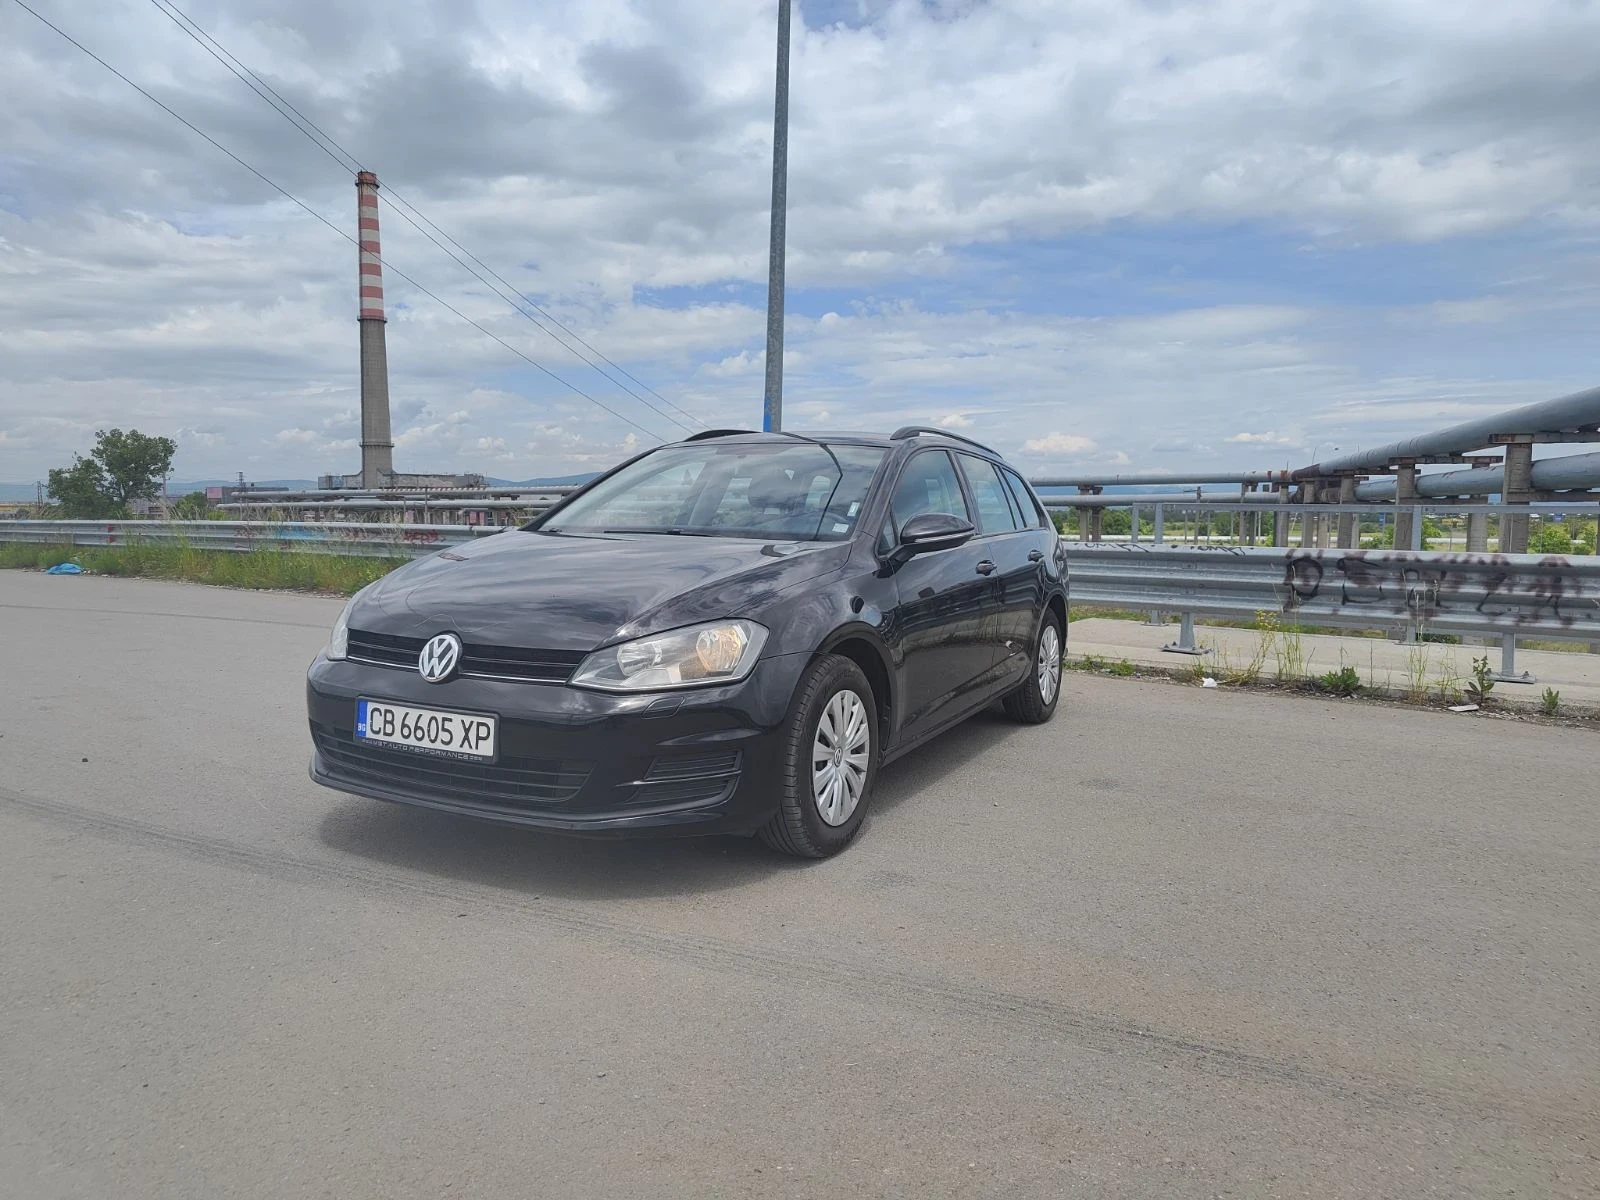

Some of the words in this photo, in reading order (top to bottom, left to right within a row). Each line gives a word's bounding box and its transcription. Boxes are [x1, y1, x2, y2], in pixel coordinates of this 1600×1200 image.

[419, 634, 459, 682] VW
[357, 722, 366, 732] BG
[370, 707, 395, 737] CB
[400, 712, 454, 746] 6605
[459, 719, 491, 750] XP
[387, 742, 408, 751] AUTO
[408, 746, 469, 760] PERFORMANCE
